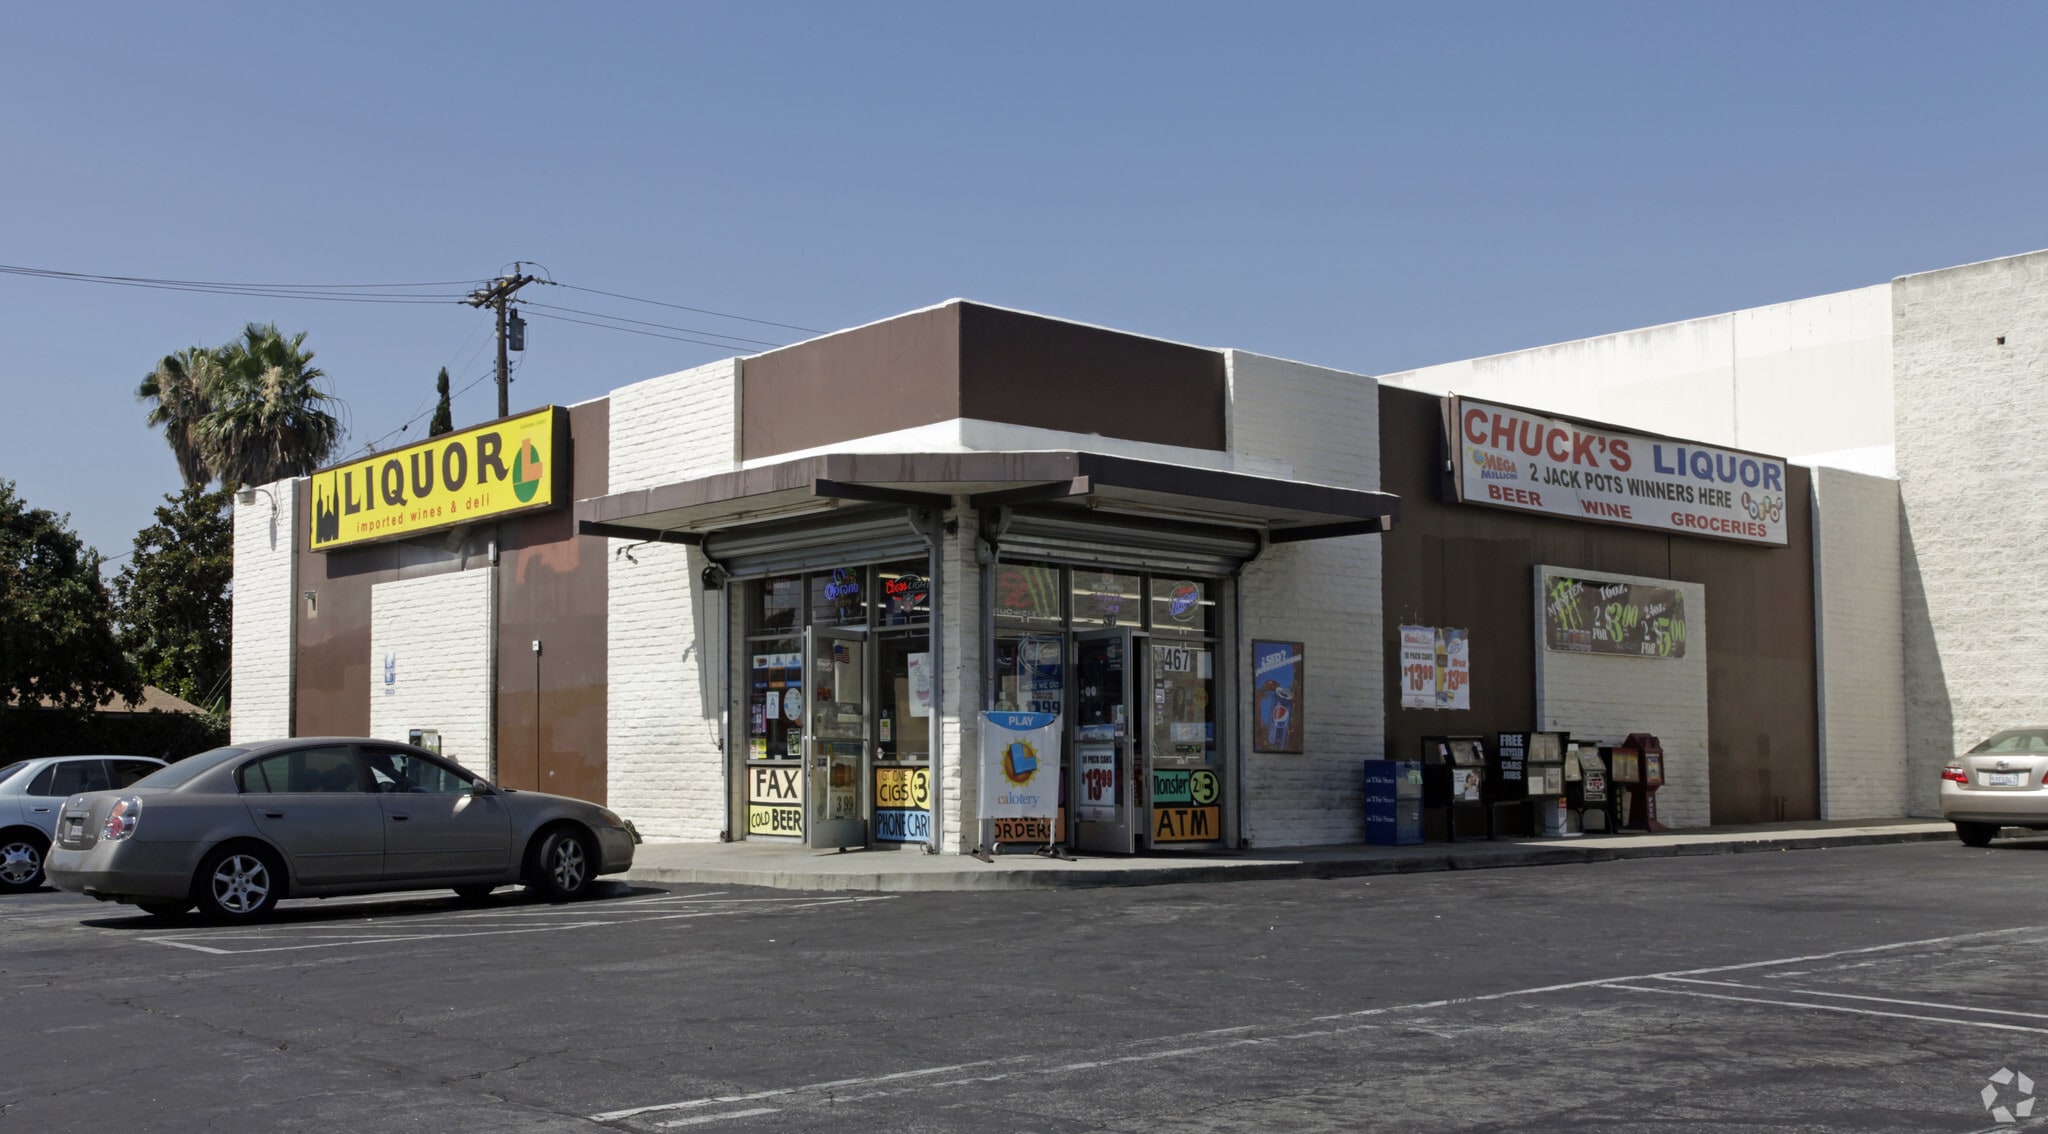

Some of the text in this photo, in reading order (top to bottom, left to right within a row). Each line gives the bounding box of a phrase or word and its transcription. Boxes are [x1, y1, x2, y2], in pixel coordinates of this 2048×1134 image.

[1464, 408, 1632, 472] CHUCK'S
[344, 432, 509, 515] LIQUOR
[1482, 452, 1517, 473] MEGA
[1653, 444, 1783, 492] LIQUOR
[1530, 463, 1732, 509] 2 JACK POTS WINNERS HERE
[356, 493, 490, 533] imported wines & deli
[1488, 484, 1767, 537] BEER WINE GROCERIES
[824, 582, 859, 600] Corona
[885, 579, 908, 594] Coors
[1594, 605, 1601, 627] 2
[1592, 628, 1608, 641] FOR
[1641, 620, 1650, 640] 2
[1641, 642, 1656, 655] FOR
[1165, 649, 1190, 671] 467
[1008, 716, 1034, 726] PLAY
[1500, 735, 1523, 747] FREE
[1502, 761, 1522, 770] CARS
[1503, 771, 1522, 780] JOBS
[756, 769, 799, 799] FAX
[880, 784, 909, 802] CIGS
[751, 809, 802, 831] COLD BEER
[877, 813, 931, 837] PHONE CAR
[1157, 810, 1209, 837] ATM
